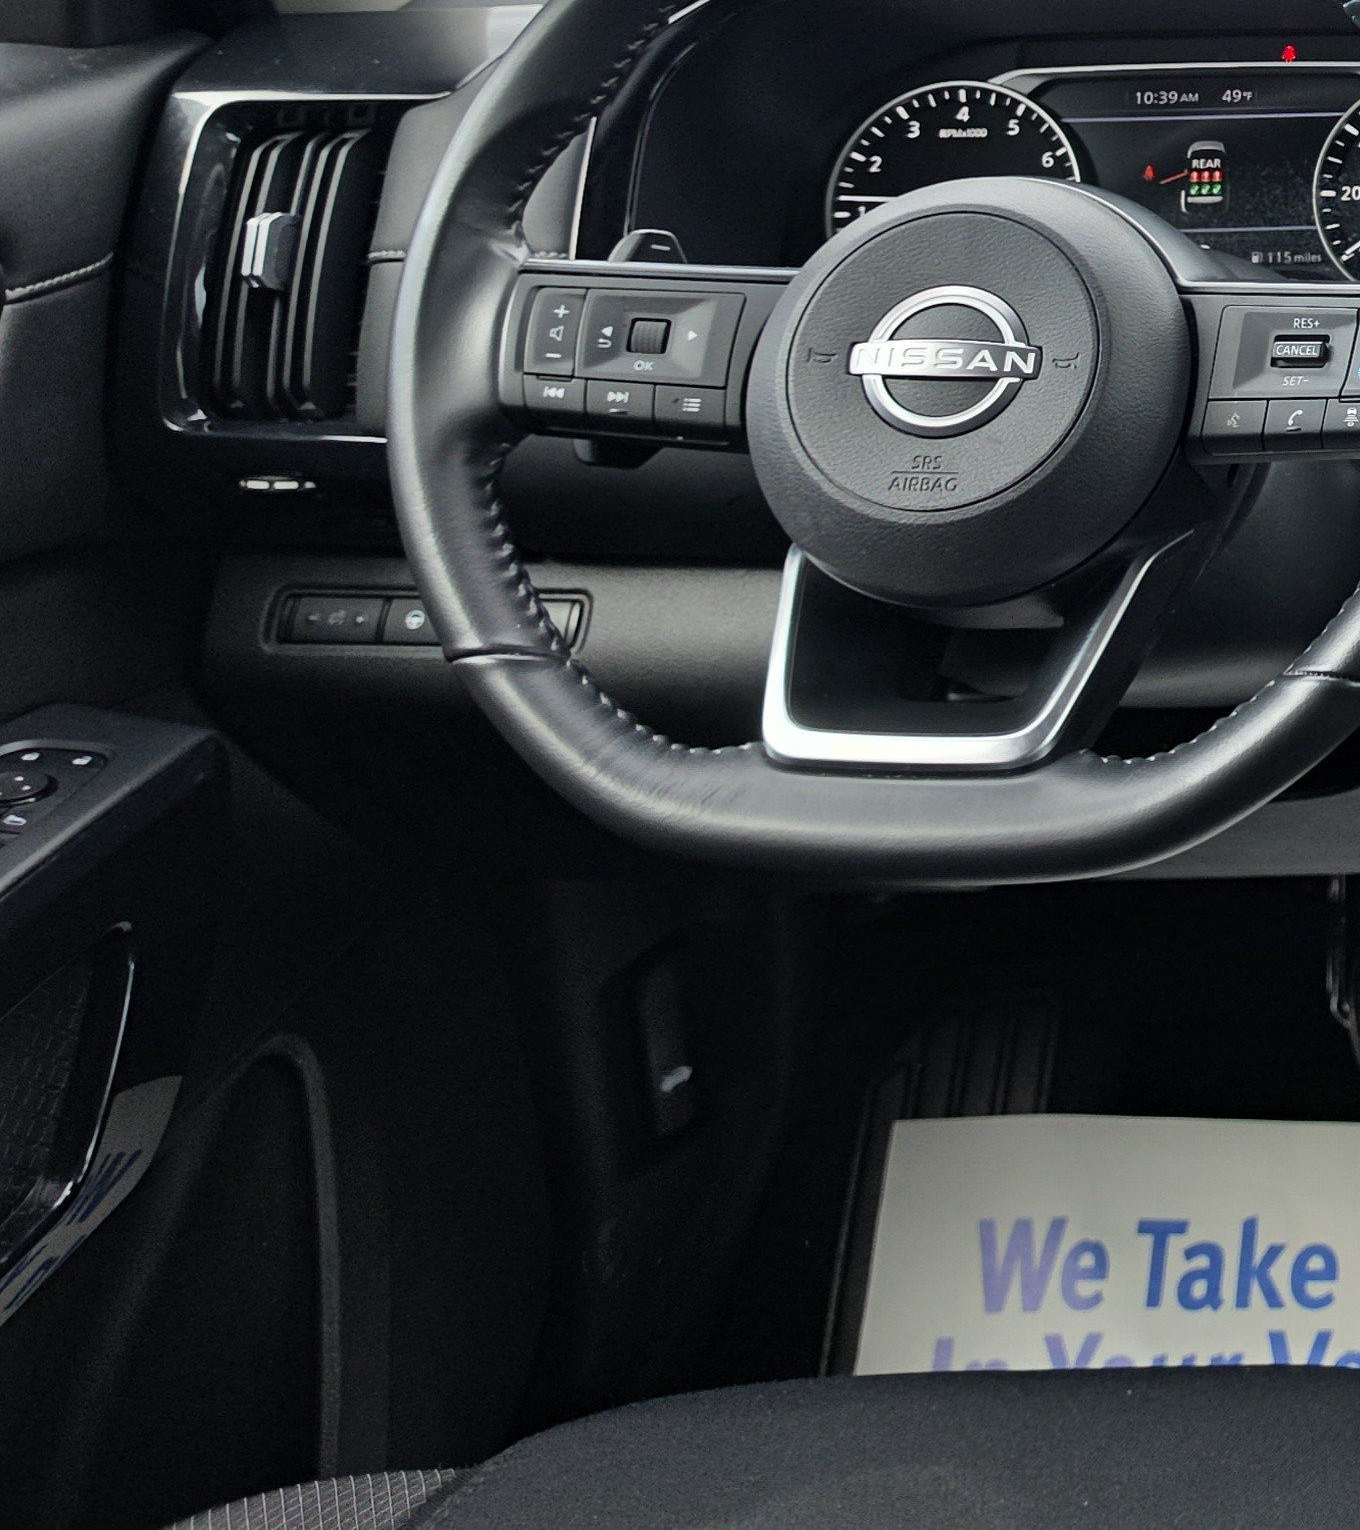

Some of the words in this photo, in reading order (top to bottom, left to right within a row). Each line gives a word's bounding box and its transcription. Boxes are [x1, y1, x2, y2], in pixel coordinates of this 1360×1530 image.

[1136, 91, 1178, 104] 10:39
[1180, 93, 1199, 102] AM
[956, 106, 970, 121] 4
[908, 121, 920, 138] 3
[1006, 120, 1019, 135] 5
[870, 156, 882, 172] 2
[1041, 151, 1054, 167] 6
[1192, 159, 1220, 168] REAR
[1268, 252, 1292, 262] 115
[1294, 253, 1321, 262] miles
[1293, 319, 1319, 328] RES+
[1276, 345, 1318, 355] CANCEL
[633, 360, 654, 370] OK
[856, 348, 1035, 373] NISSAN
[912, 456, 942, 469] SRS
[888, 477, 957, 492] AIRBAG
[977, 1216, 1109, 1313] We
[1137, 1216, 1339, 1311] Take
